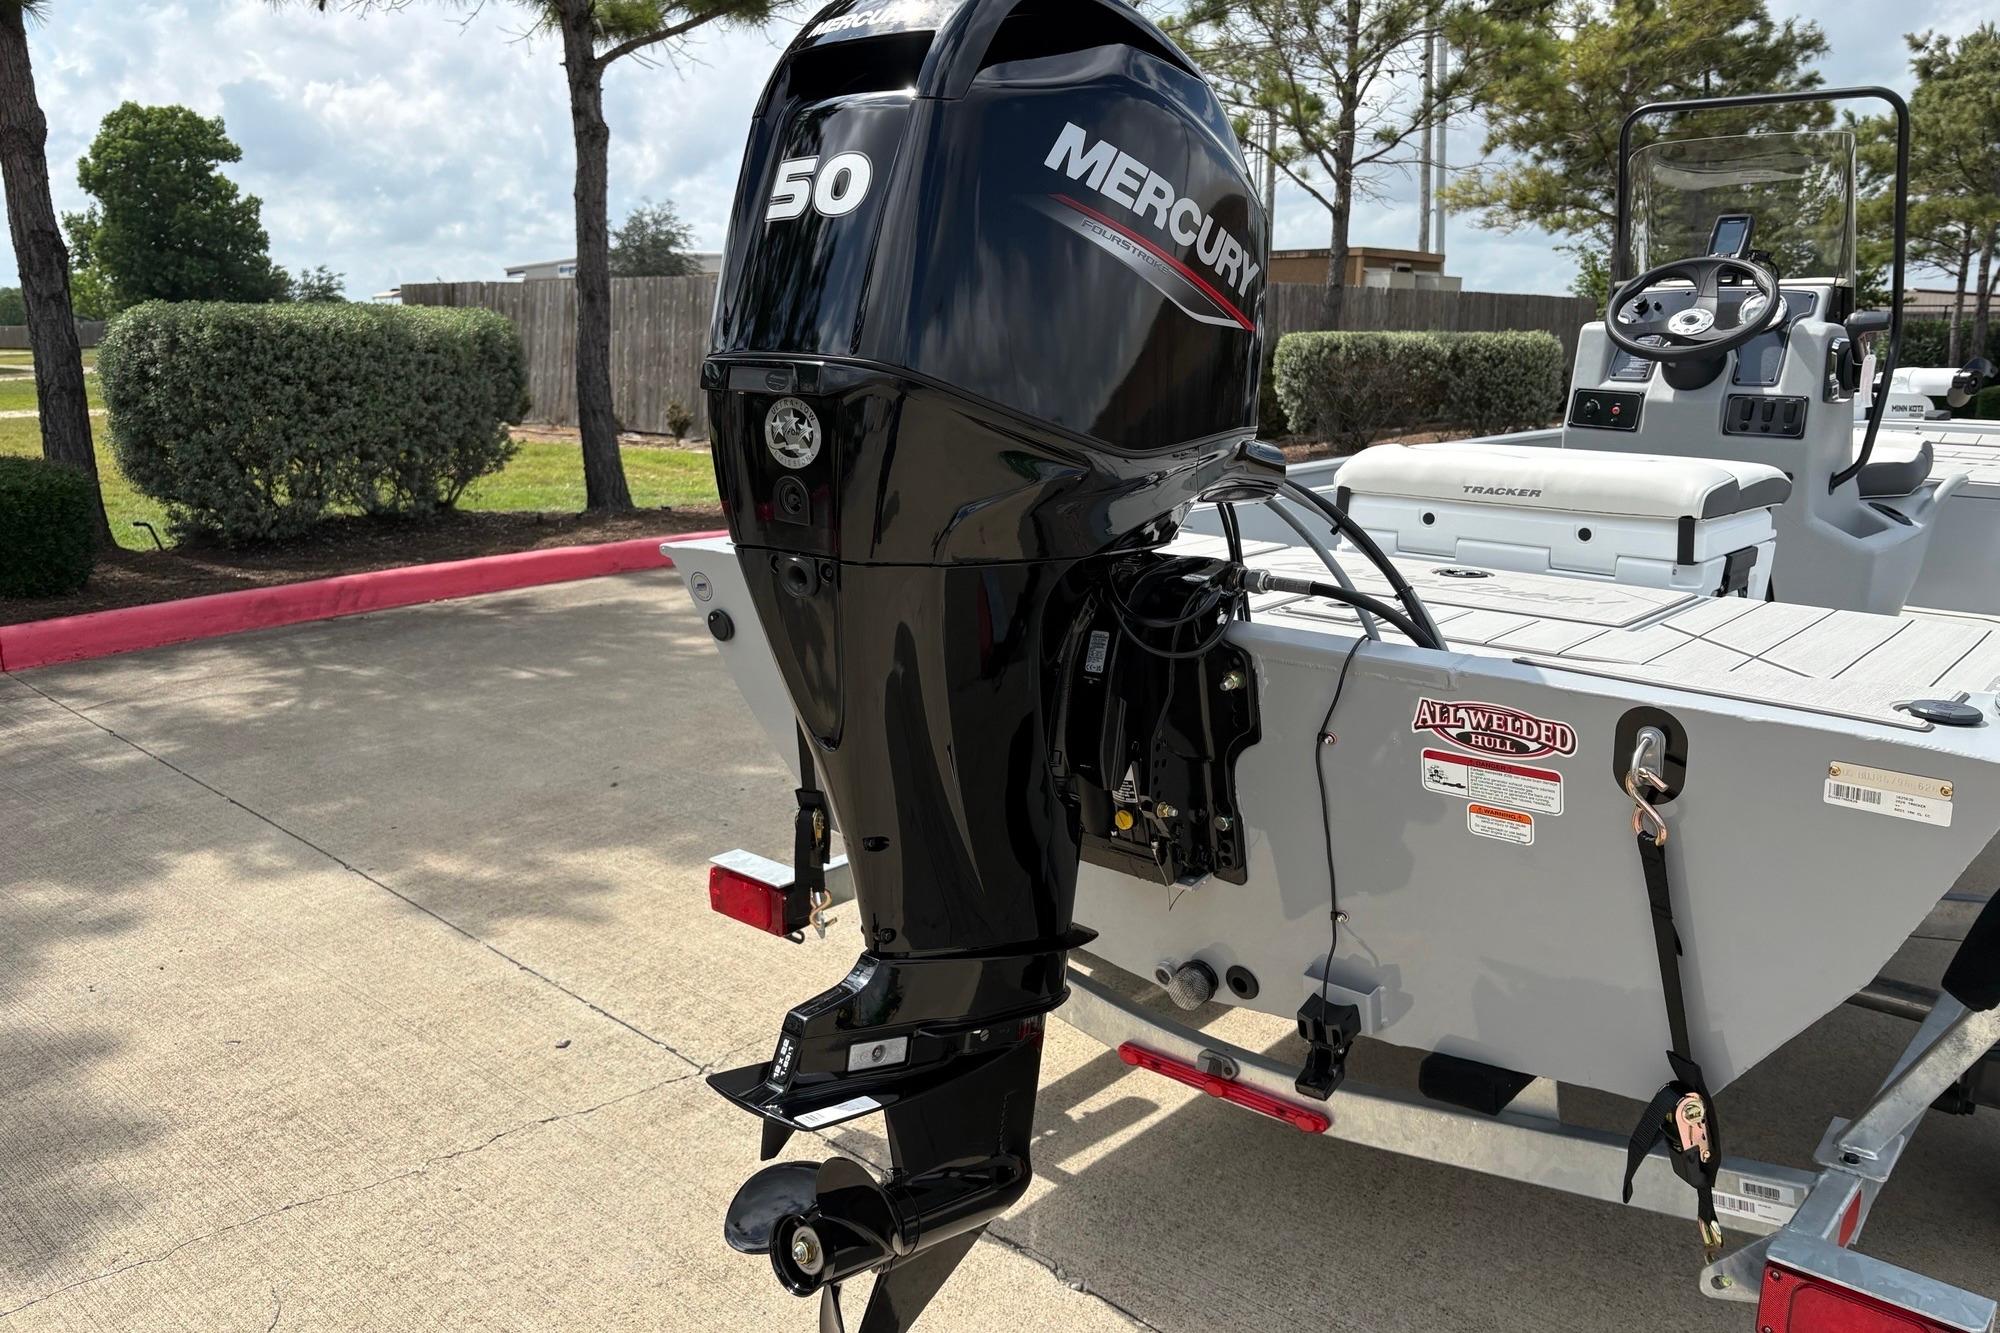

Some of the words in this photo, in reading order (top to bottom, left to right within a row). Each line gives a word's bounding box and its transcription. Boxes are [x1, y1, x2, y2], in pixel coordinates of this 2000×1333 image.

[764, 150, 873, 222] 50
[1043, 121, 1260, 298] MERCURY
[1081, 218, 1170, 275] FOURSTROKE
[1891, 404, 1908, 413] MINN
[1462, 485, 1542, 498] TRACKER
[1414, 699, 1464, 729] ALL
[1466, 708, 1575, 753] WELDED
[1470, 733, 1516, 752] HULL
[1483, 807, 1517, 821] WARNING
